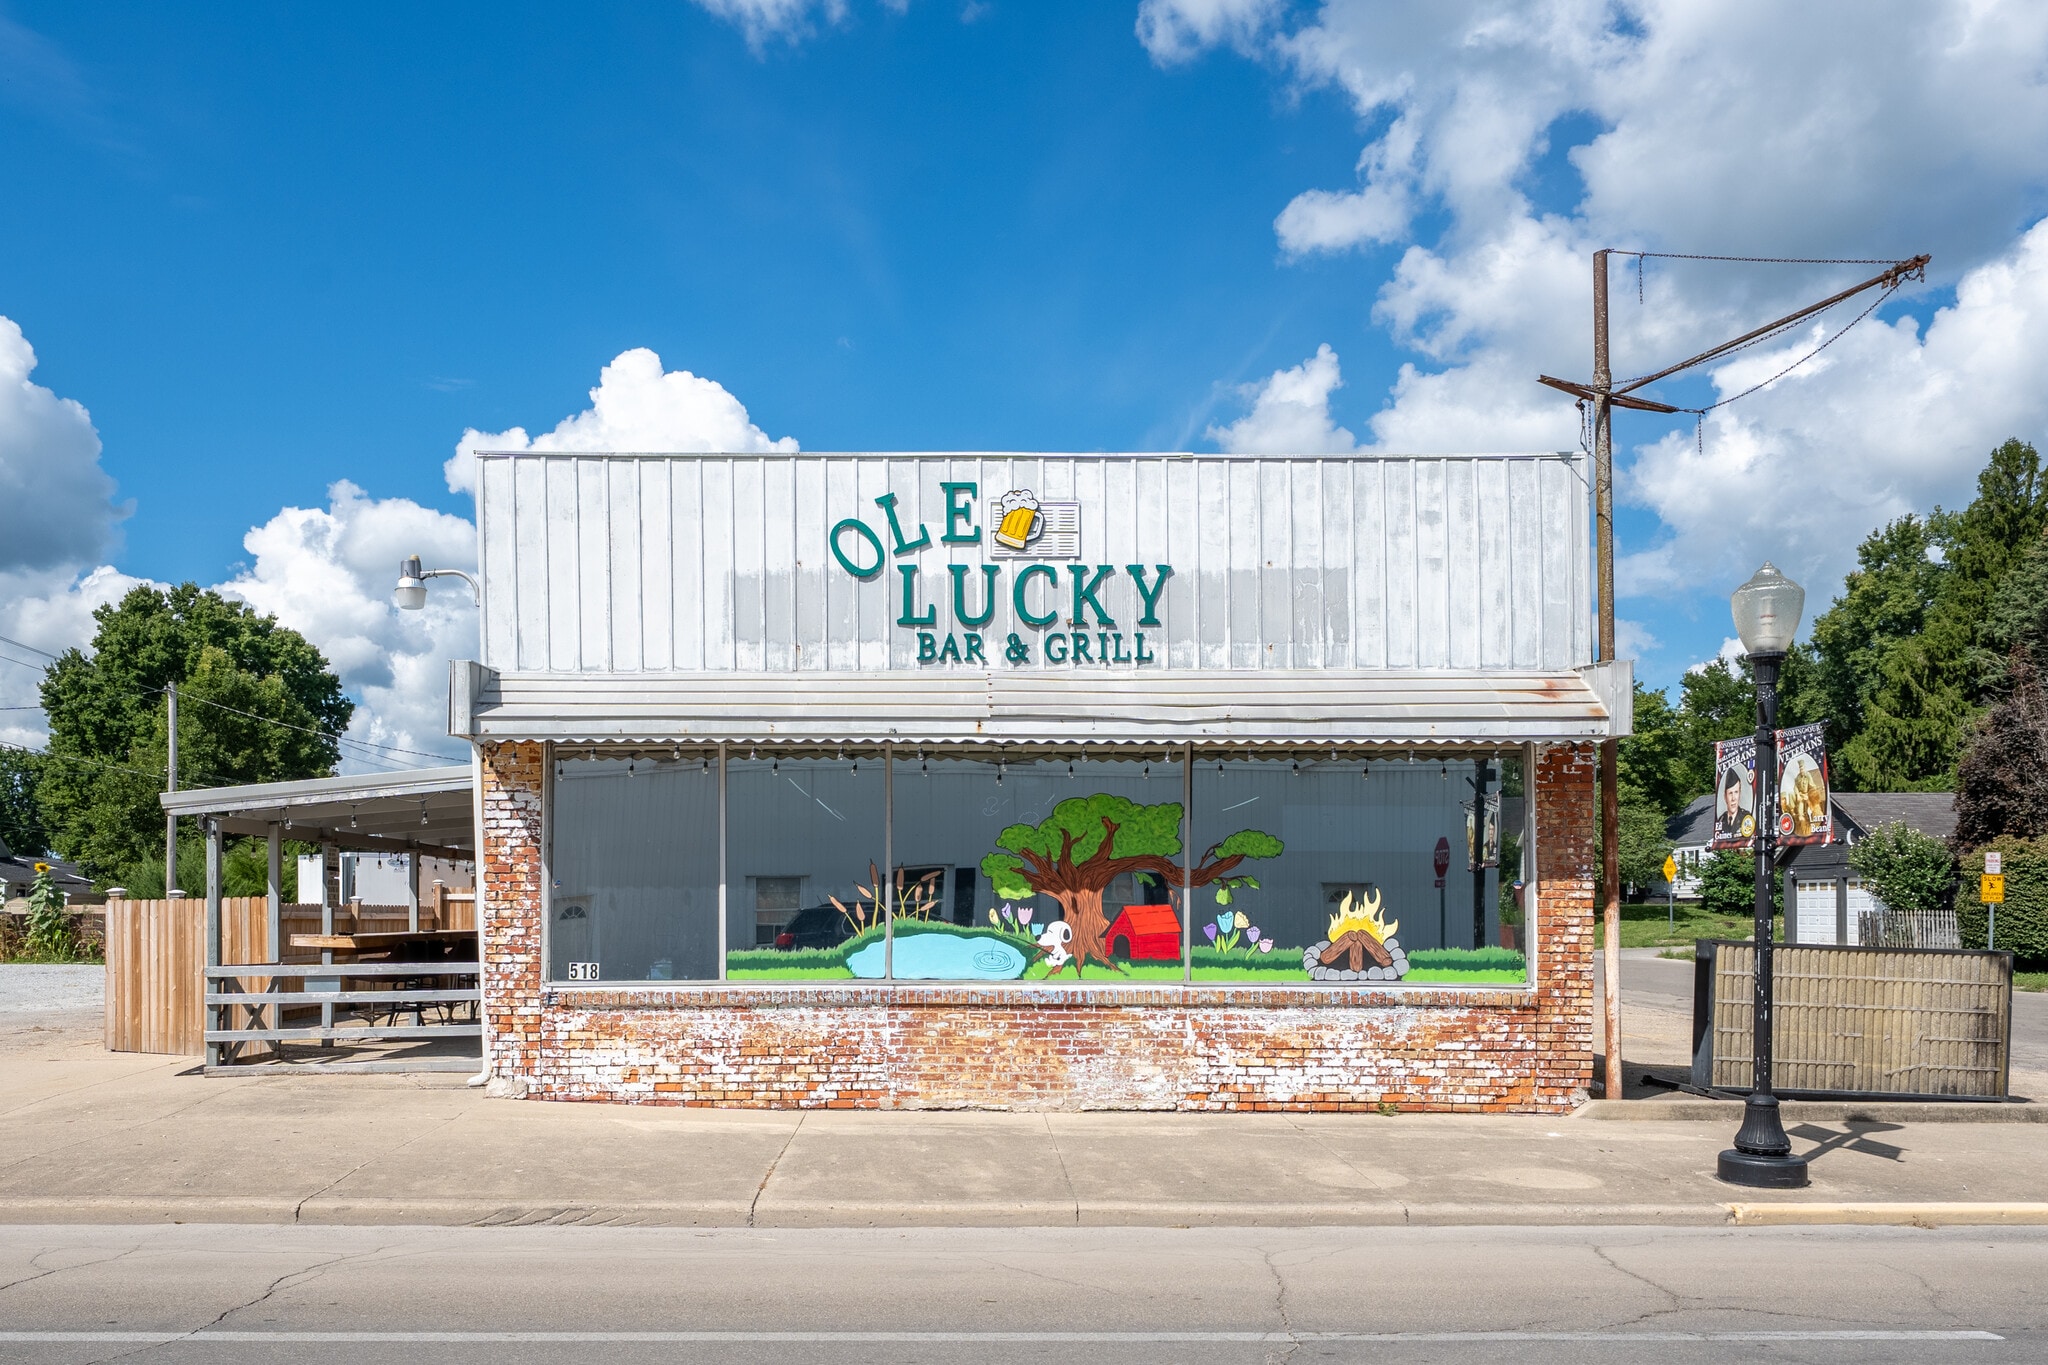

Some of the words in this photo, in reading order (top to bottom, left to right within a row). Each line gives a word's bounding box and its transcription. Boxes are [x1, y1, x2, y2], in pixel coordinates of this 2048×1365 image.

[830, 482, 981, 578] OLE
[897, 564, 1173, 626] LUCKY
[917, 632, 986, 662] BAR
[1006, 634, 1029, 662] &
[1045, 632, 1154, 662] GRILL
[1718, 747, 1756, 771] VETERANS
[1779, 735, 1823, 762] VETERANS
[1715, 821, 1723, 830] Ed
[1809, 813, 1828, 824] Larry
[570, 963, 598, 979] 518
